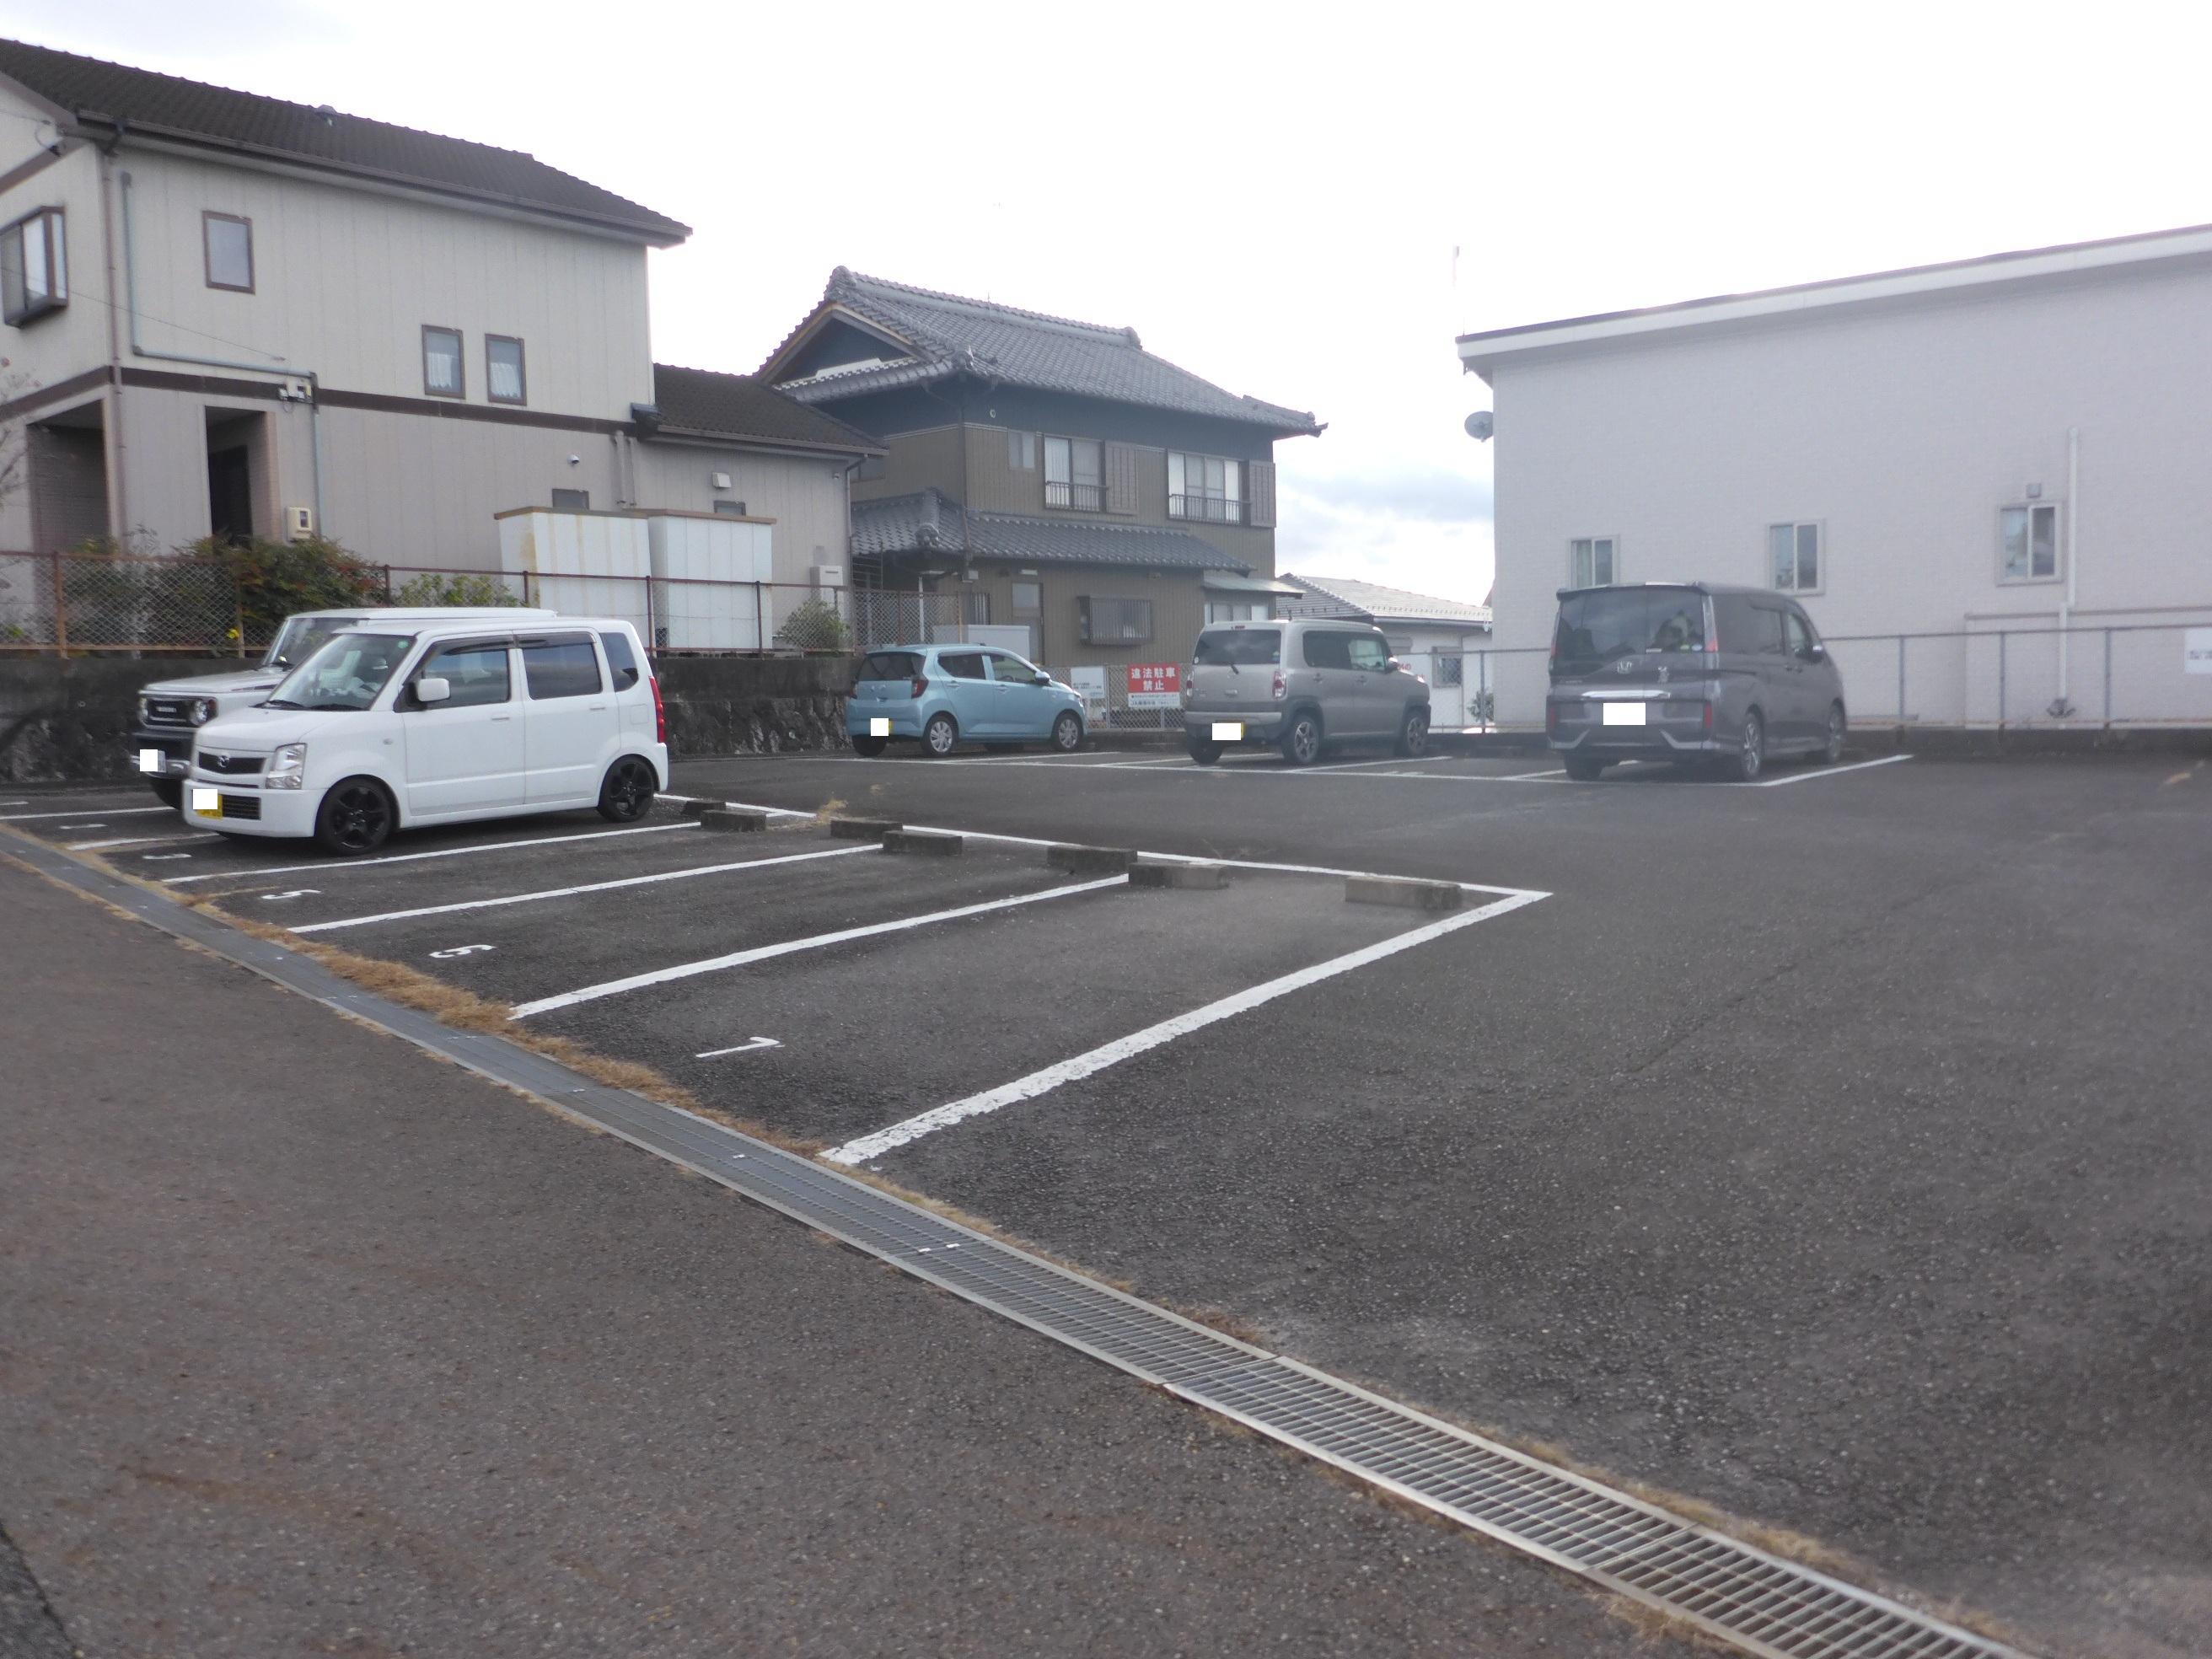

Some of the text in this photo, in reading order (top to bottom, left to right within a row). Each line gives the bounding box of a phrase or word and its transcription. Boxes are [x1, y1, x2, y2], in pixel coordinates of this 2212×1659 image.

[1131, 667, 1175, 679] 違法駐車
[1143, 679, 1164, 691] 禁止
